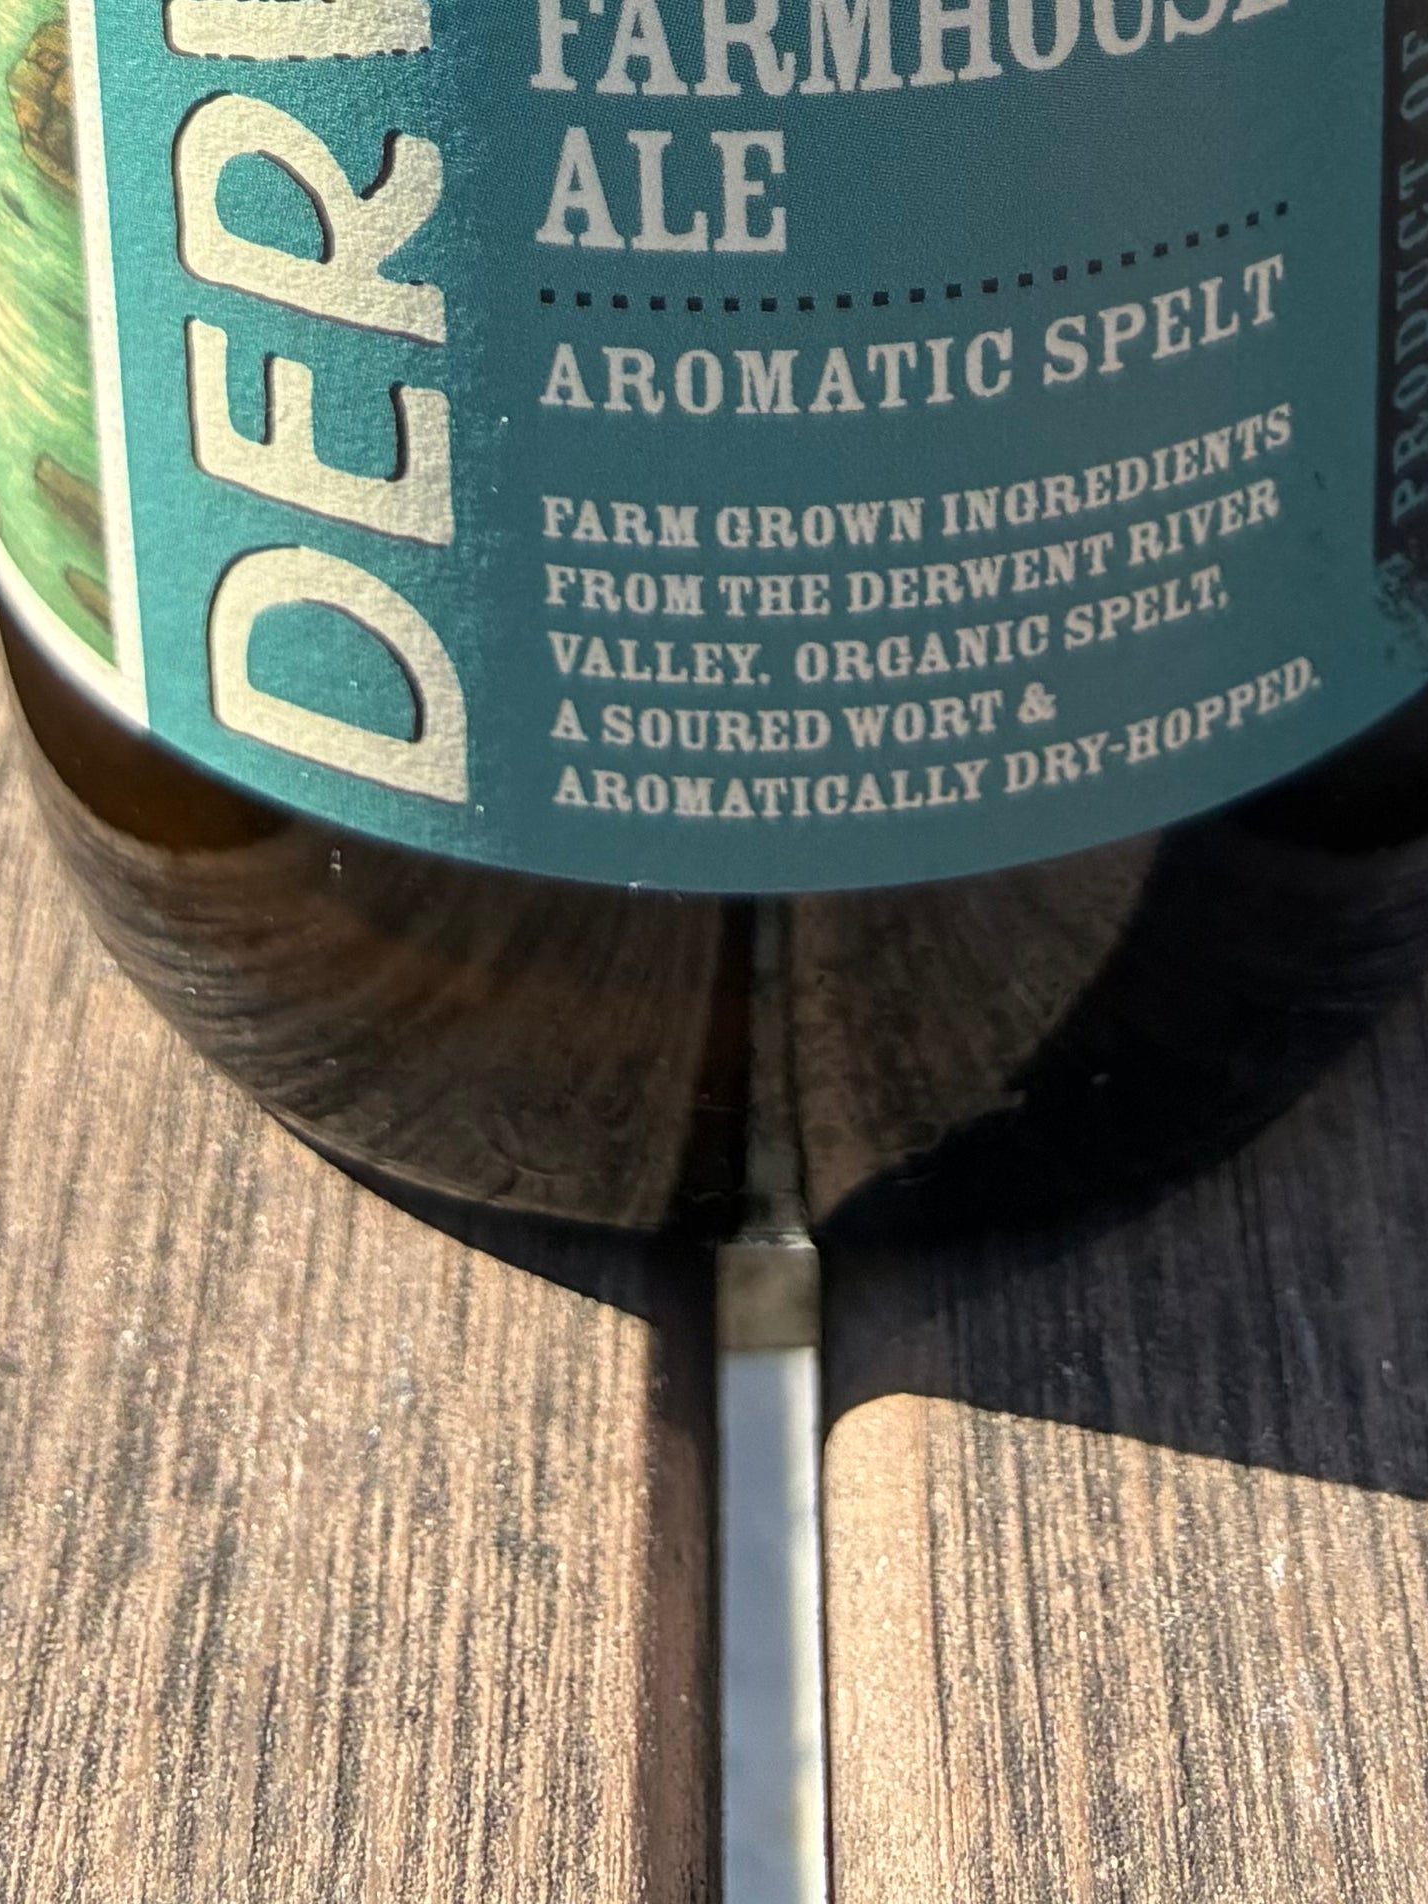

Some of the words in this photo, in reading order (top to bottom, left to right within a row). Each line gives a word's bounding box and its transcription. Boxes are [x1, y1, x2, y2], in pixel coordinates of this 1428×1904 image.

[535, 126, 787, 253] ALE
[538, 326, 1015, 418] AROMATIC
[1043, 253, 1287, 386] SPELT
[541, 494, 700, 548] FARM
[716, 496, 925, 550] GROWN
[940, 403, 1294, 537] INGREDIENTS
[544, 562, 705, 617] FROM
[719, 571, 832, 618] THE
[845, 532, 1115, 616] DERWENT
[1126, 477, 1280, 566] RIVER
[548, 631, 772, 686] VALLEY.
[794, 613, 1050, 685] ORGANIC
[1063, 565, 1231, 652] SPELT,
[551, 699, 589, 743] A
[601, 704, 832, 754] SOURED
[842, 690, 1004, 749] WORT
[1018, 681, 1058, 724] &
[553, 759, 984, 819] AROMATICALLY
[1003, 654, 1323, 795] DRY-HOPPED.
